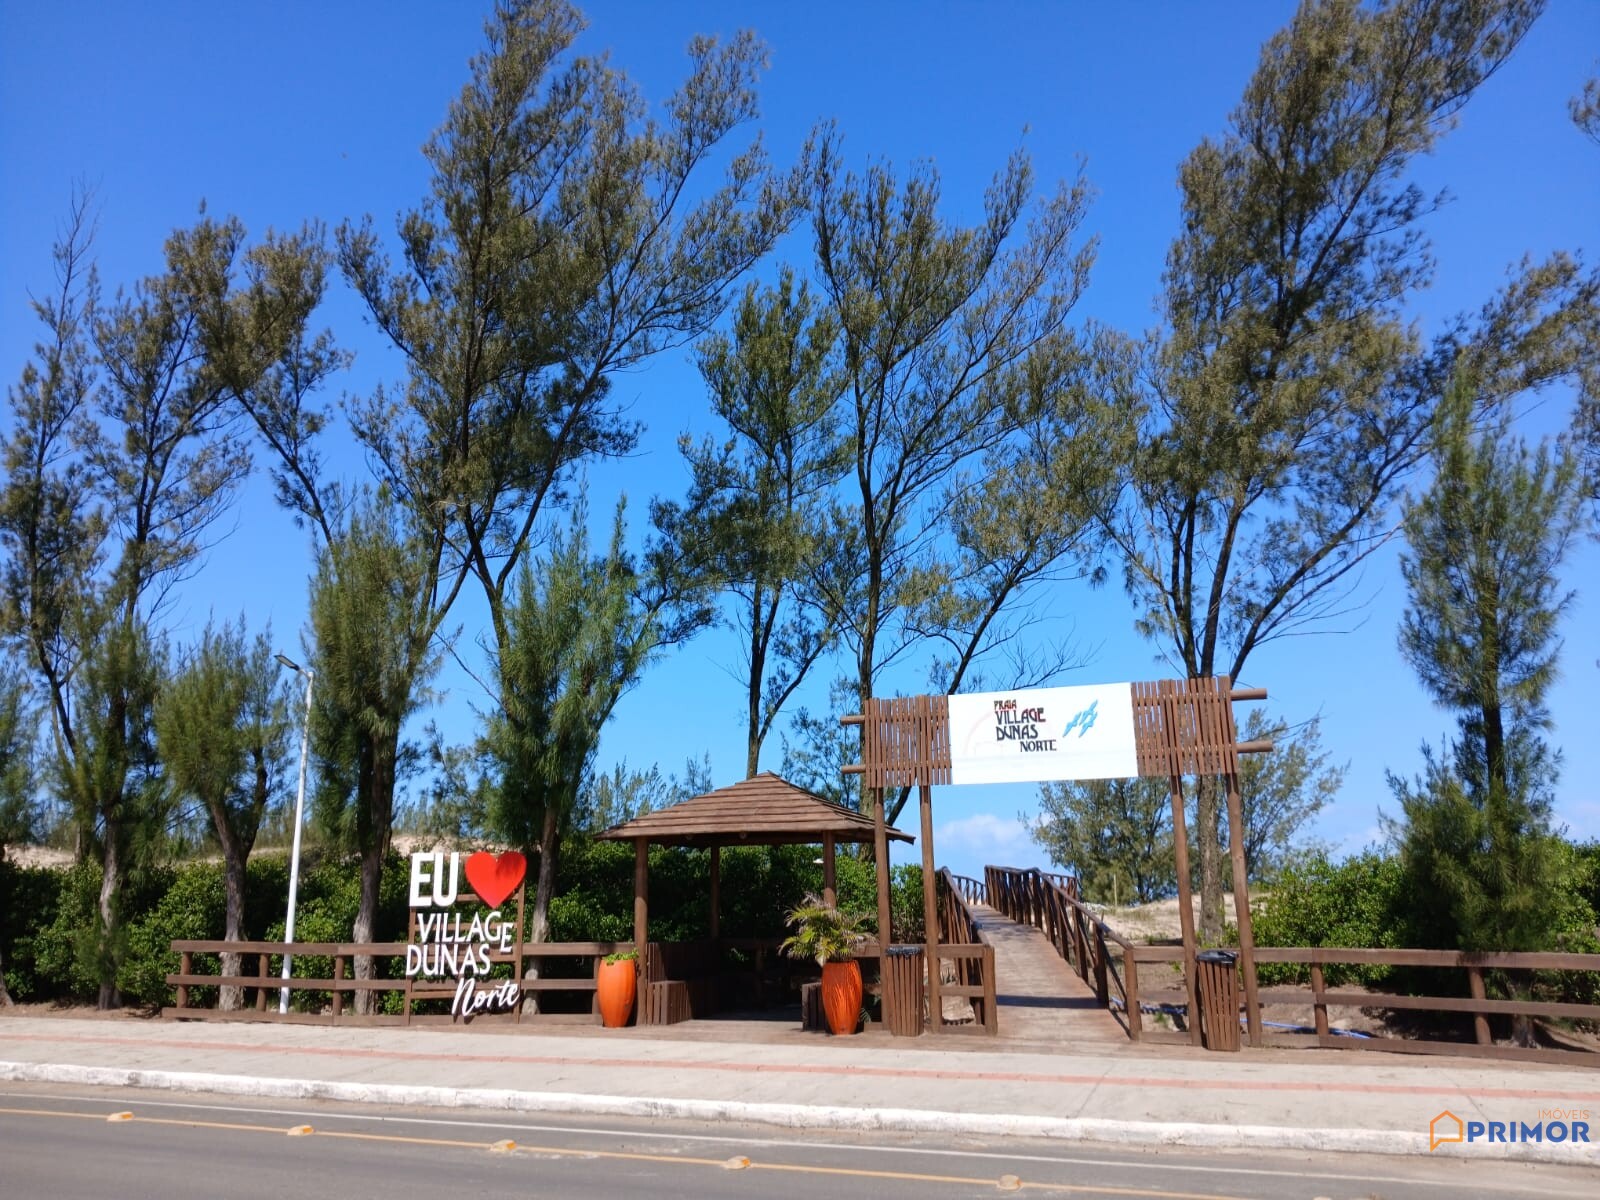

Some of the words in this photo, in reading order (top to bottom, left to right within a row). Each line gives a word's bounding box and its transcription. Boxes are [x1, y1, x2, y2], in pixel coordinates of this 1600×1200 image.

[994, 699, 1017, 710] PRAIA
[994, 708, 1046, 725] VILLAGE
[996, 724, 1038, 741] DUNAS
[1020, 739, 1057, 752] NORTE
[409, 852, 460, 907] EU
[417, 911, 514, 953] VILLAGE
[406, 943, 491, 976] DUNAS
[451, 977, 520, 1017] Norte
